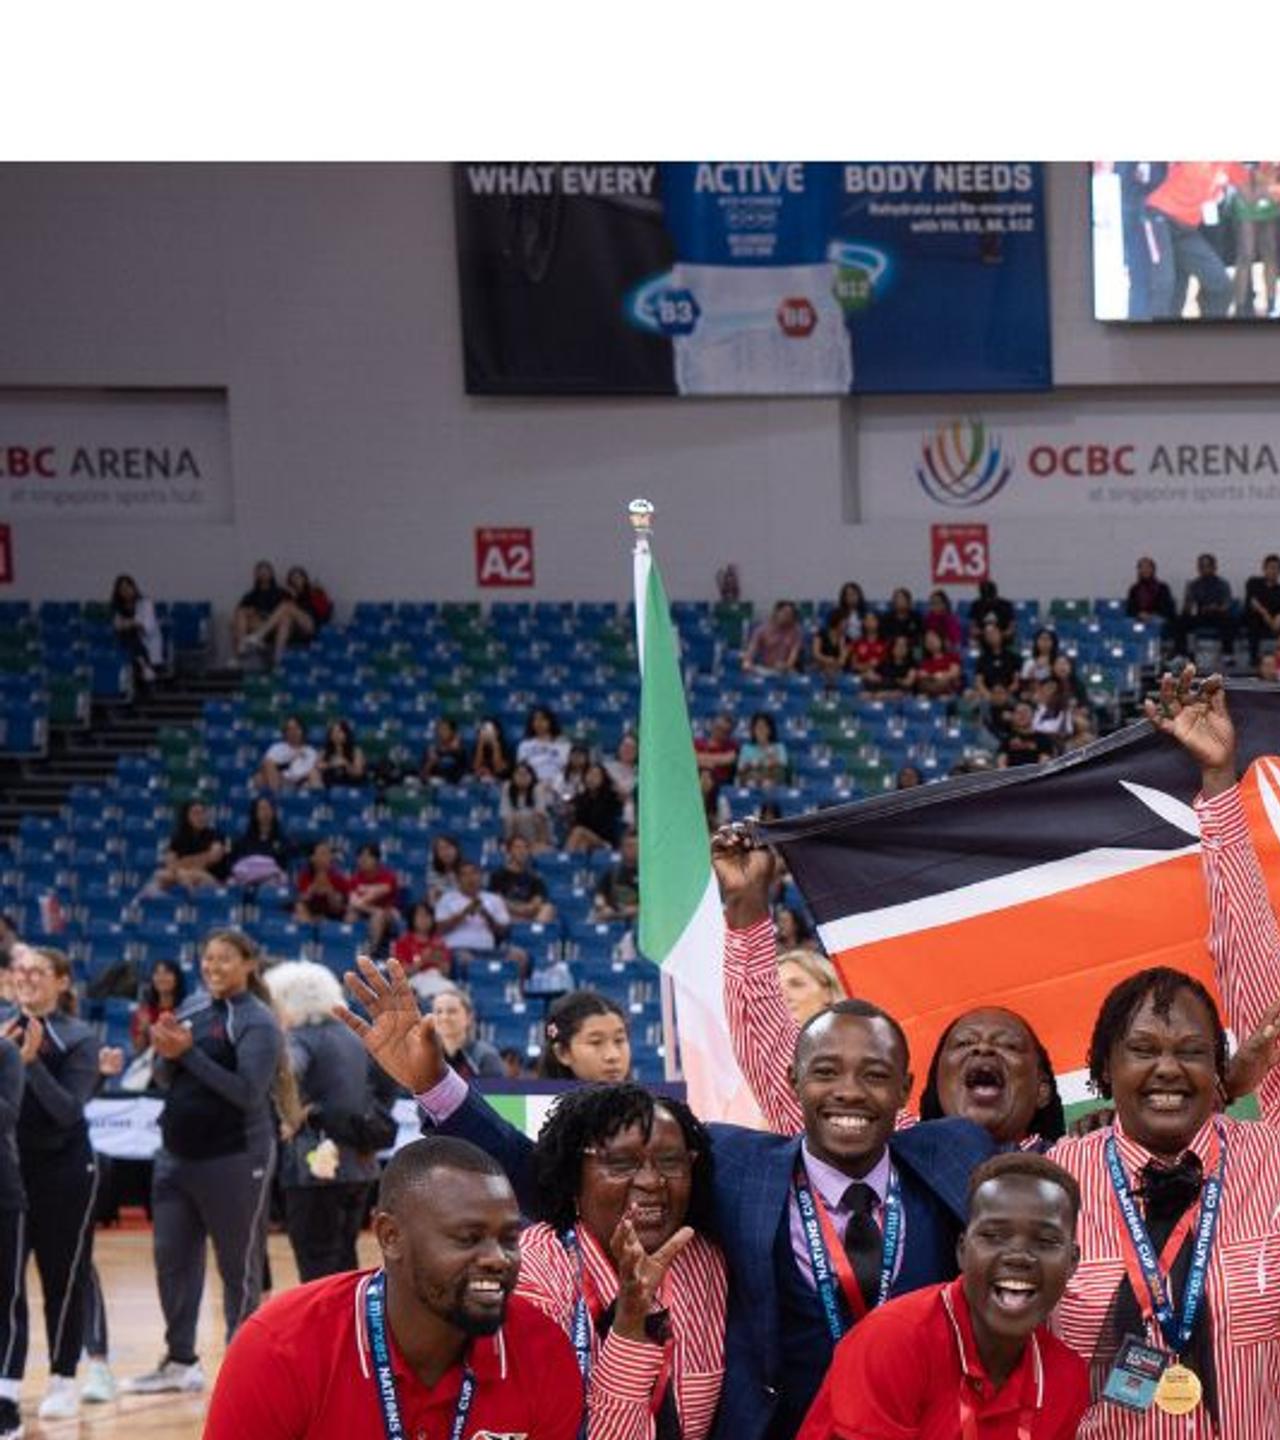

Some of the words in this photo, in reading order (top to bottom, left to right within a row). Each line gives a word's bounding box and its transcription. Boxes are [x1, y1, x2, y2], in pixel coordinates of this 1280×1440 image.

[468, 166, 557, 193] WHAT
[562, 166, 655, 193] EVERY
[695, 163, 805, 192] ACTIVE
[845, 165, 927, 192] BODY
[934, 165, 1032, 192] NEEDS
[911, 219, 939, 232] with
[660, 301, 693, 324] B3
[0, 446, 56, 478] BC
[70, 447, 200, 479] ARENA
[1028, 445, 1135, 477] OCBC
[1148, 444, 1280, 475] ARENA
[480, 547, 532, 580] A2
[935, 542, 986, 577] A3
[800, 1190, 814, 1216] CUP
[1118, 1187, 1144, 1243] NATIONS
[1139, 1243, 1155, 1270] CUP
[1196, 1212, 1214, 1268] NATIONS
[1205, 1182, 1219, 1209] CUP
[806, 1219, 830, 1281] NATIONS
[369, 1301, 388, 1362] mirxes
[378, 1367, 402, 1433] NATIONS
[457, 1379, 473, 1411] CUP
